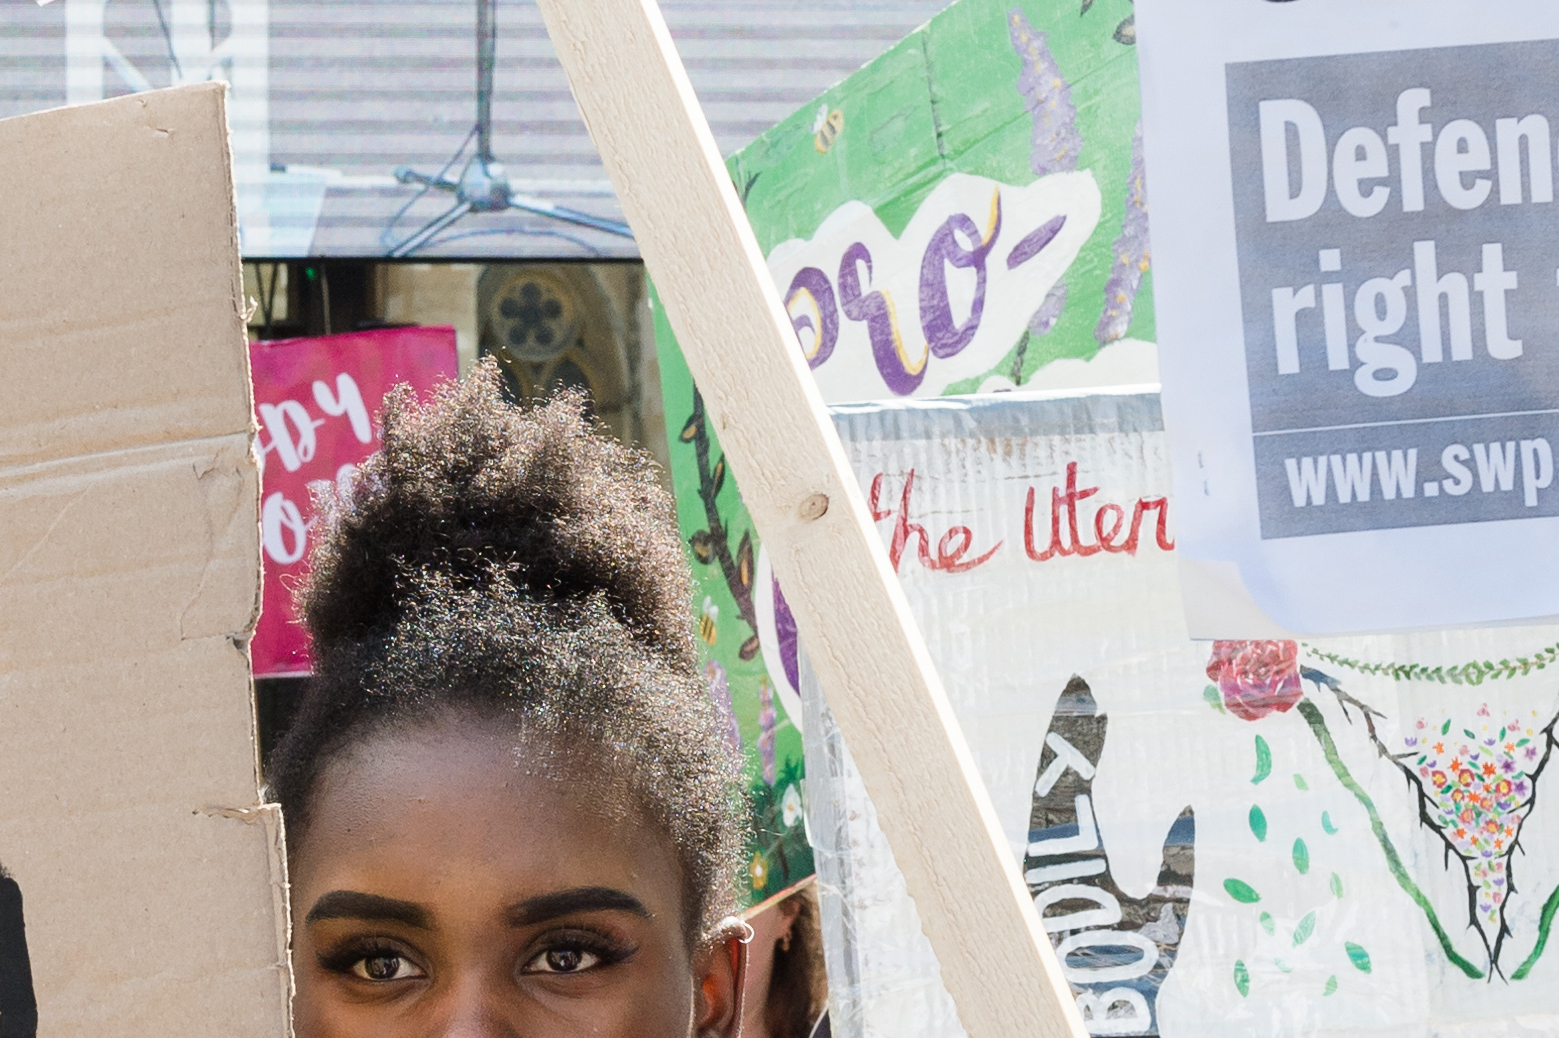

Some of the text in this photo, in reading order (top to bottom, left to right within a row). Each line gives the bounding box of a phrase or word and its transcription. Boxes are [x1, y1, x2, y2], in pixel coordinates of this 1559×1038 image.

[1258, 88, 1559, 223] Defen
[1271, 240, 1524, 397] right
[1284, 436, 1559, 508] www.swp
[1024, 730, 1160, 1037] BODILY
